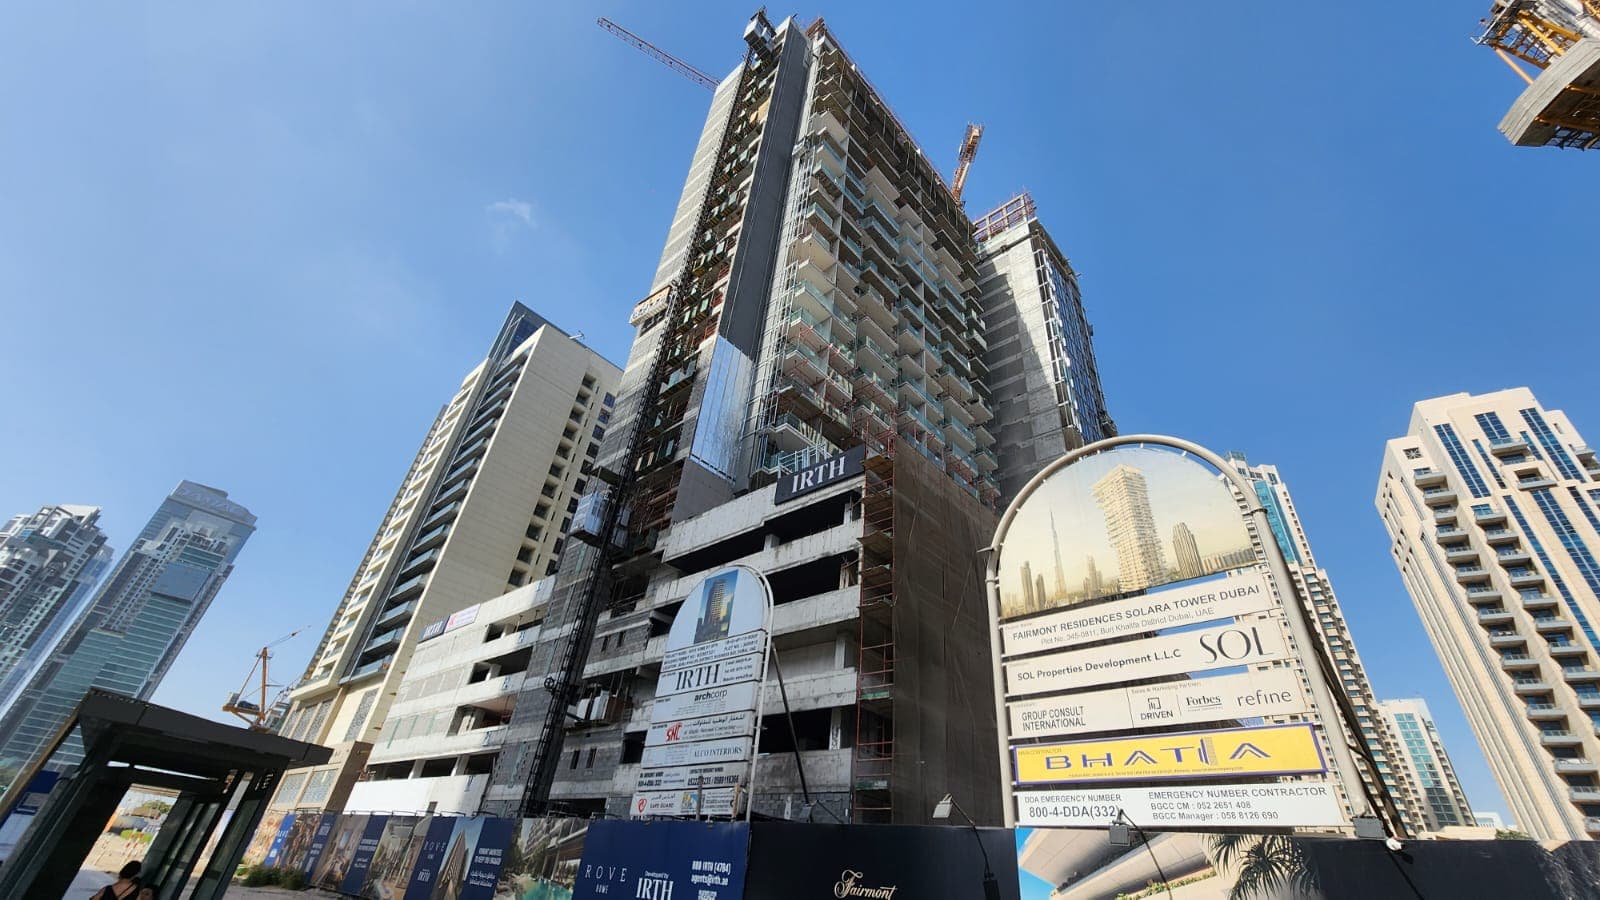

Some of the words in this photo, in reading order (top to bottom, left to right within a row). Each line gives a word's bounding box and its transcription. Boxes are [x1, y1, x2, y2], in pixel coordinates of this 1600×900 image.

[791, 456, 846, 493] IRTH
[1013, 626, 1059, 640] FAIRMONT
[1060, 612, 1123, 630] RESIDENCES
[1125, 603, 1171, 619] SOLARA
[1172, 593, 1217, 610] TOWER
[1220, 584, 1260, 600] DUBAI
[1141, 617, 1168, 628] District
[1195, 607, 1215, 617] UAE
[1199, 626, 1275, 664] SOL
[1017, 671, 1036, 681] SOL
[1037, 664, 1083, 679] Properties
[1085, 653, 1151, 673] Development
[1154, 648, 1182, 661] L.L.C
[675, 663, 721, 691] IRTH
[694, 689, 728, 702] archcorp
[1185, 695, 1223, 706] Forbes
[1236, 689, 1292, 707] refine
[1021, 709, 1048, 721] GROUP
[1048, 705, 1084, 720] CONSULT
[1140, 710, 1174, 721] DRIVEN
[1022, 717, 1087, 731] INTERNATIONAL
[1045, 738, 1272, 770] BHATIA
[1024, 796, 1040, 804] DDA
[1040, 794, 1086, 803] EMERGENCY
[1087, 793, 1122, 802] NUMBER
[1148, 790, 1204, 800] EMERGENCY
[1206, 788, 1250, 799] NUMBER
[1251, 786, 1328, 797] CONTRACTOR
[1150, 802, 1175, 810] BGCC
[1176, 801, 1190, 809] CM
[1196, 801, 1212, 810] 052
[1213, 801, 1233, 809] 2651
[1236, 801, 1252, 809] 408
[1152, 812, 1177, 820] BGCC
[1178, 812, 1214, 821] Manager
[1262, 811, 1279, 819] 690
[585, 864, 628, 882] ROVE
[636, 877, 674, 900] IRTH
[834, 869, 898, 900] Fairmont
